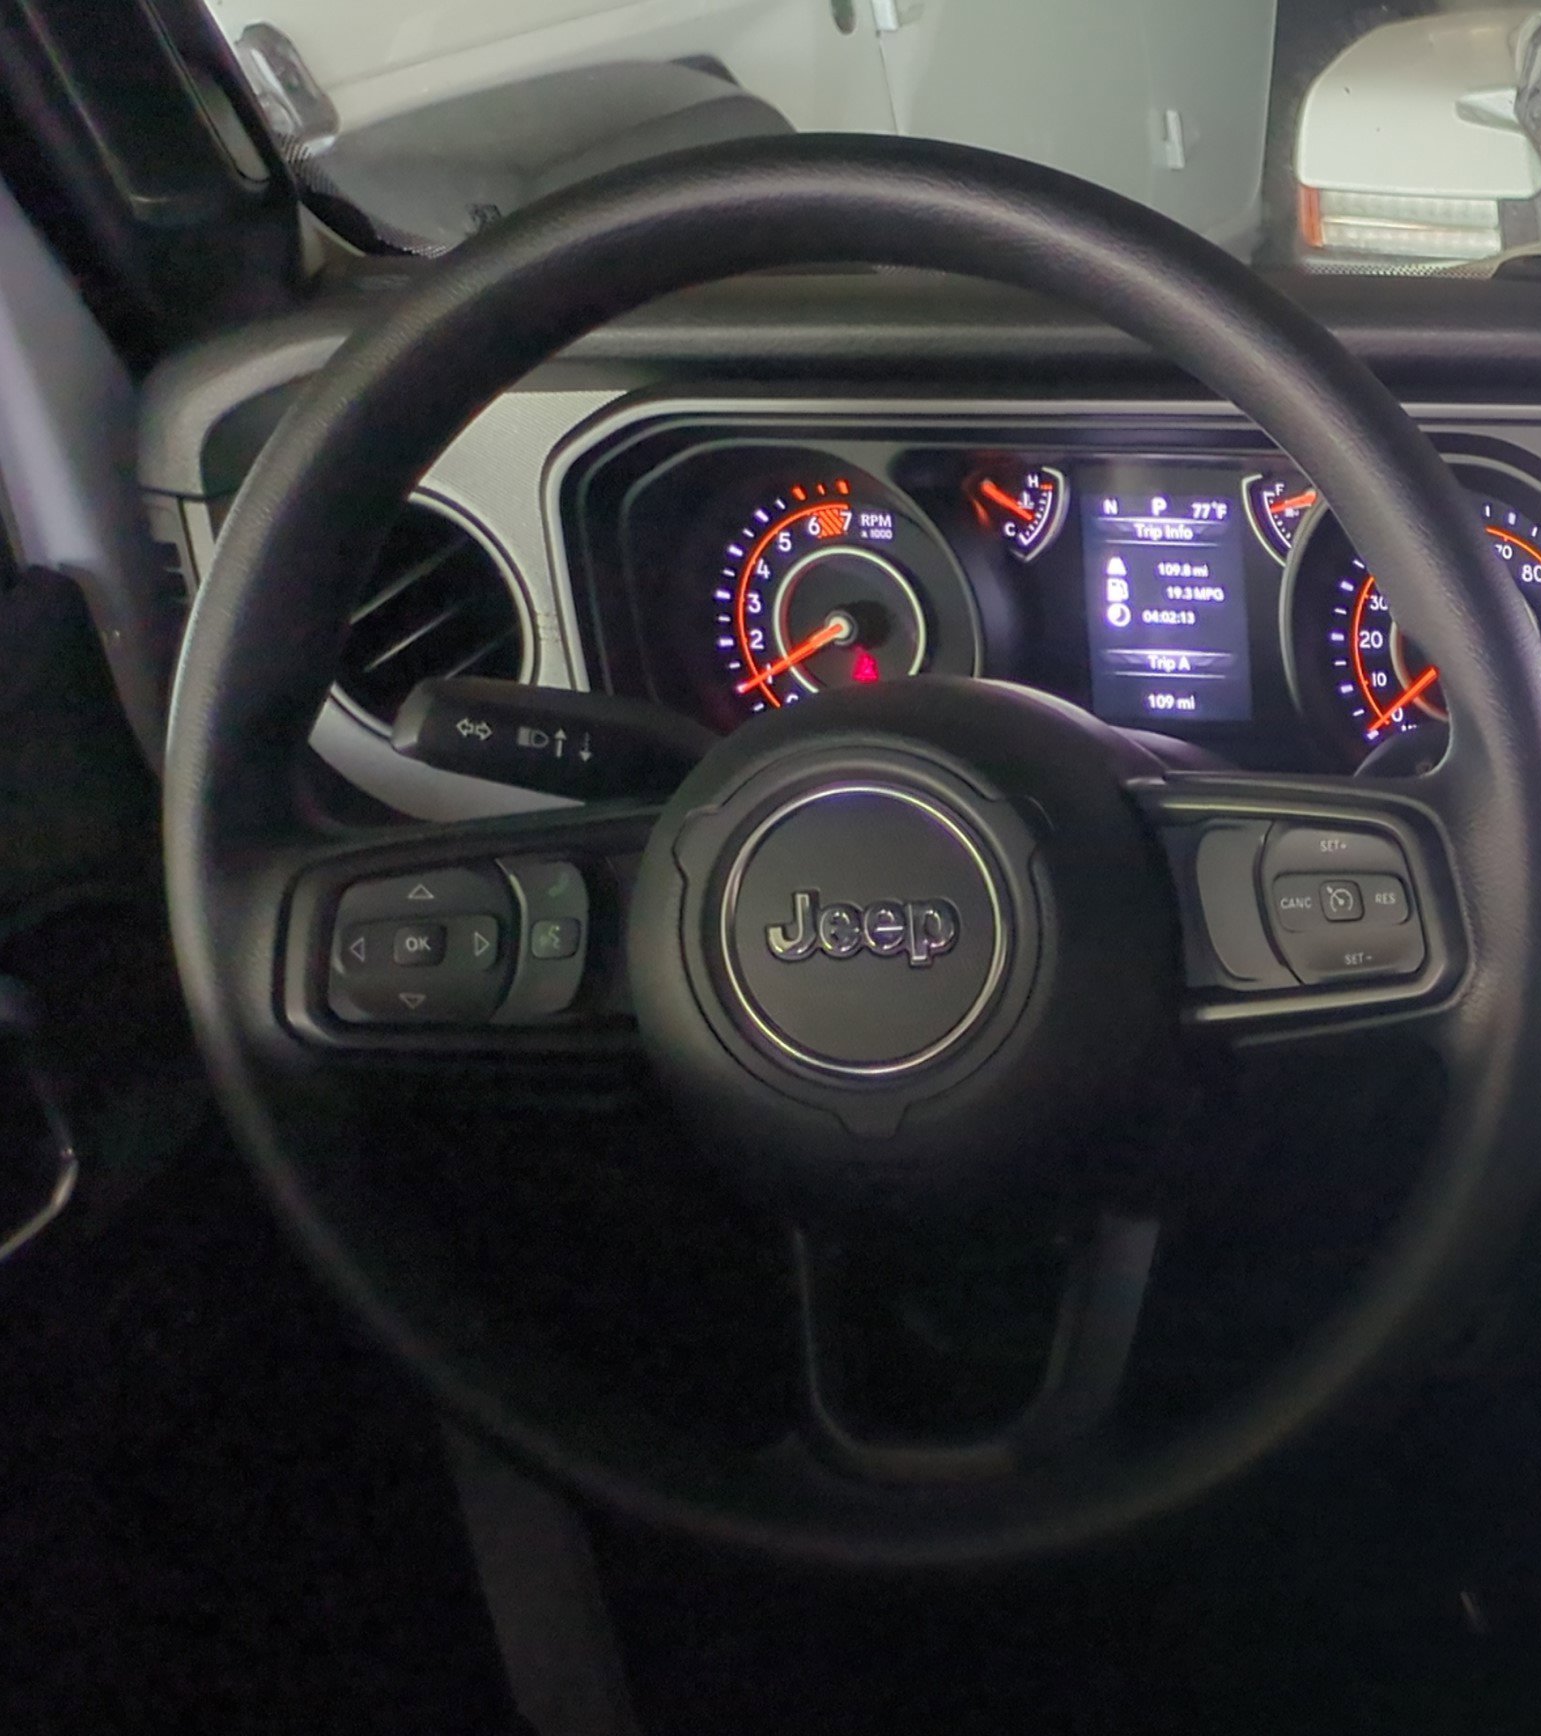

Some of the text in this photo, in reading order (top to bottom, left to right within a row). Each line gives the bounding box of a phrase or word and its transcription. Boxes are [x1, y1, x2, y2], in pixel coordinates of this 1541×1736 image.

[1027, 475, 1039, 488] H
[1274, 484, 1285, 497] F
[1103, 499, 1118, 515] N
[1151, 496, 1167, 517] P
[808, 516, 820, 535] 6
[839, 511, 852, 531] 7
[860, 512, 892, 528] RPM
[1004, 522, 1016, 537] C
[1133, 522, 1194, 541] Trip Info
[778, 532, 792, 552] 5
[756, 557, 770, 579] 4
[747, 592, 762, 613] 3
[750, 629, 764, 650] 2
[1358, 630, 1384, 649] 20
[1147, 655, 1191, 672] Trip A
[1371, 671, 1388, 688] 10
[1147, 694, 1196, 711] 109 mi
[765, 886, 960, 968] Jeep
[405, 936, 431, 952] OK
